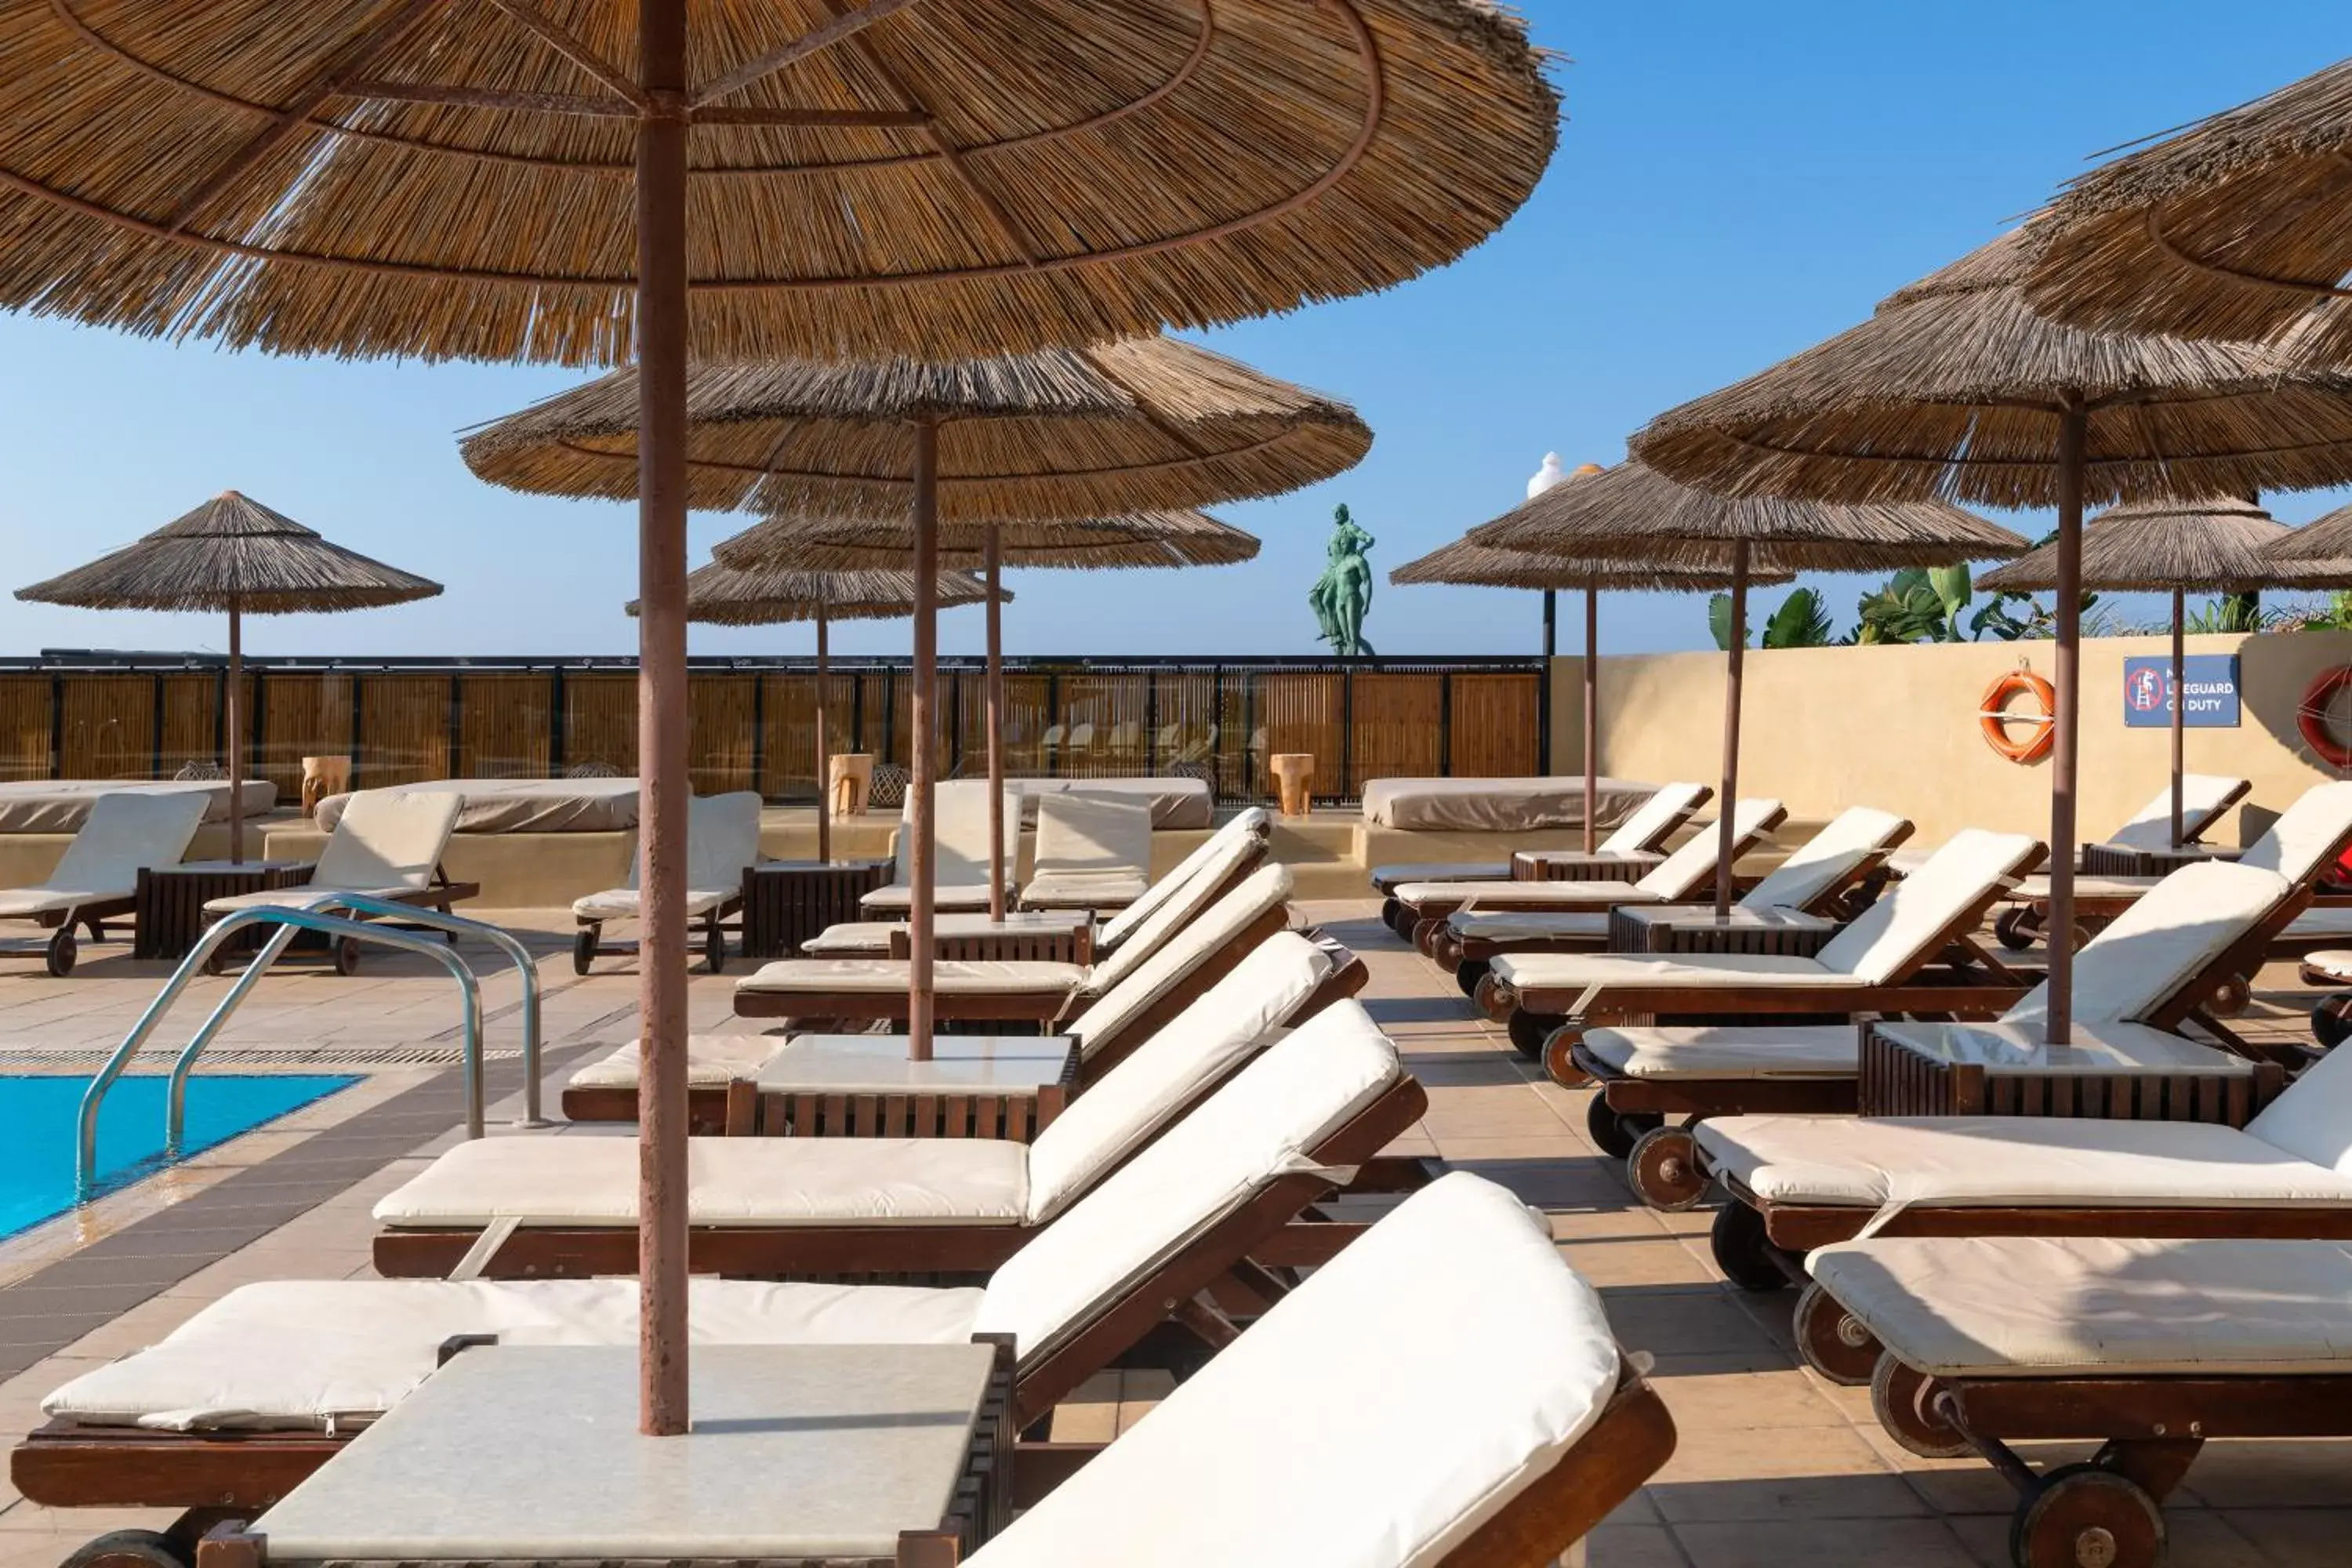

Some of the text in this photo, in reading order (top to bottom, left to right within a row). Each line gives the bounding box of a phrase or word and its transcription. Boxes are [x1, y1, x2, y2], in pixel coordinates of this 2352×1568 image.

[2166, 668, 2185, 678] N
[2166, 683, 2234, 695] LEGUARD
[2188, 699, 2221, 711] DUTY
